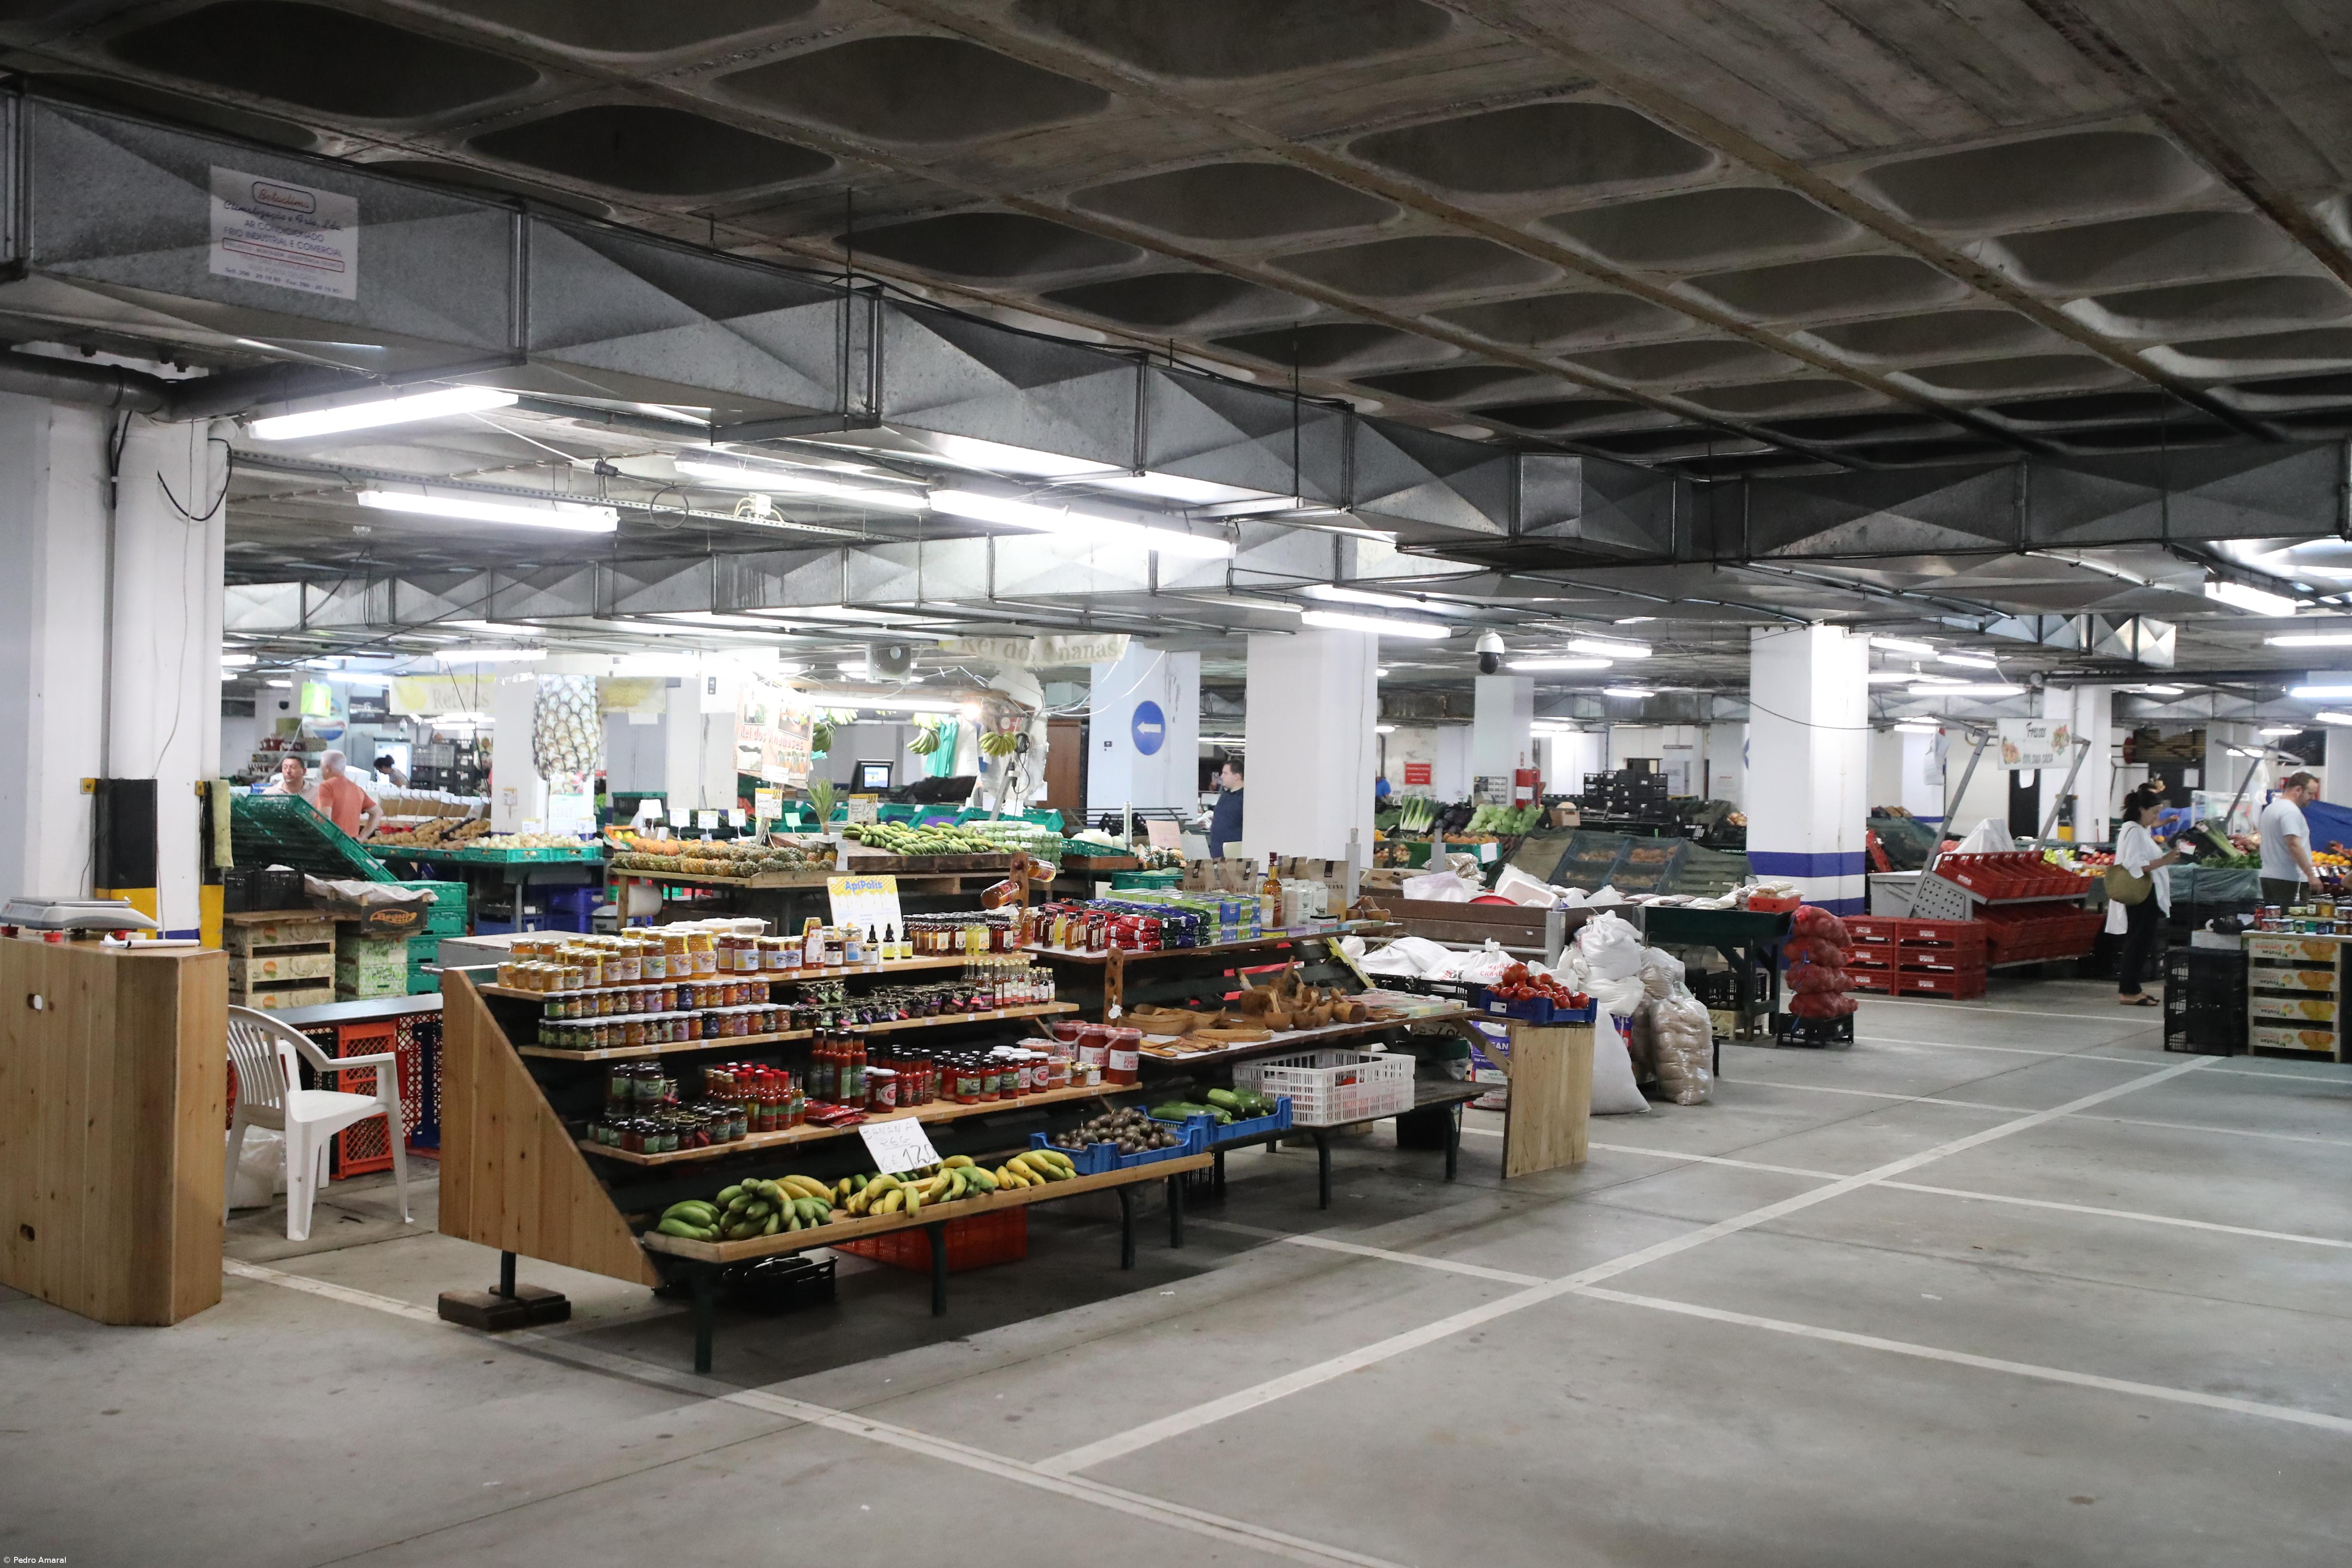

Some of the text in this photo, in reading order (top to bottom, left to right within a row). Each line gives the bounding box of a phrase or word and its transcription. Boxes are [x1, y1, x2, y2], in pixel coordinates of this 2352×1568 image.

[224, 227, 243, 237] FRIO
[246, 231, 288, 246] INDUSTRIAL
[297, 242, 343, 257] COMERCIAL
[245, 220, 324, 242] AR CONDICIONADO
[1002, 640, 1035, 662] dos
[433, 686, 458, 709] Rei
[754, 728, 766, 742] dos
[845, 880, 883, 892] ApiPolis
[860, 1121, 914, 1139] BANANA
